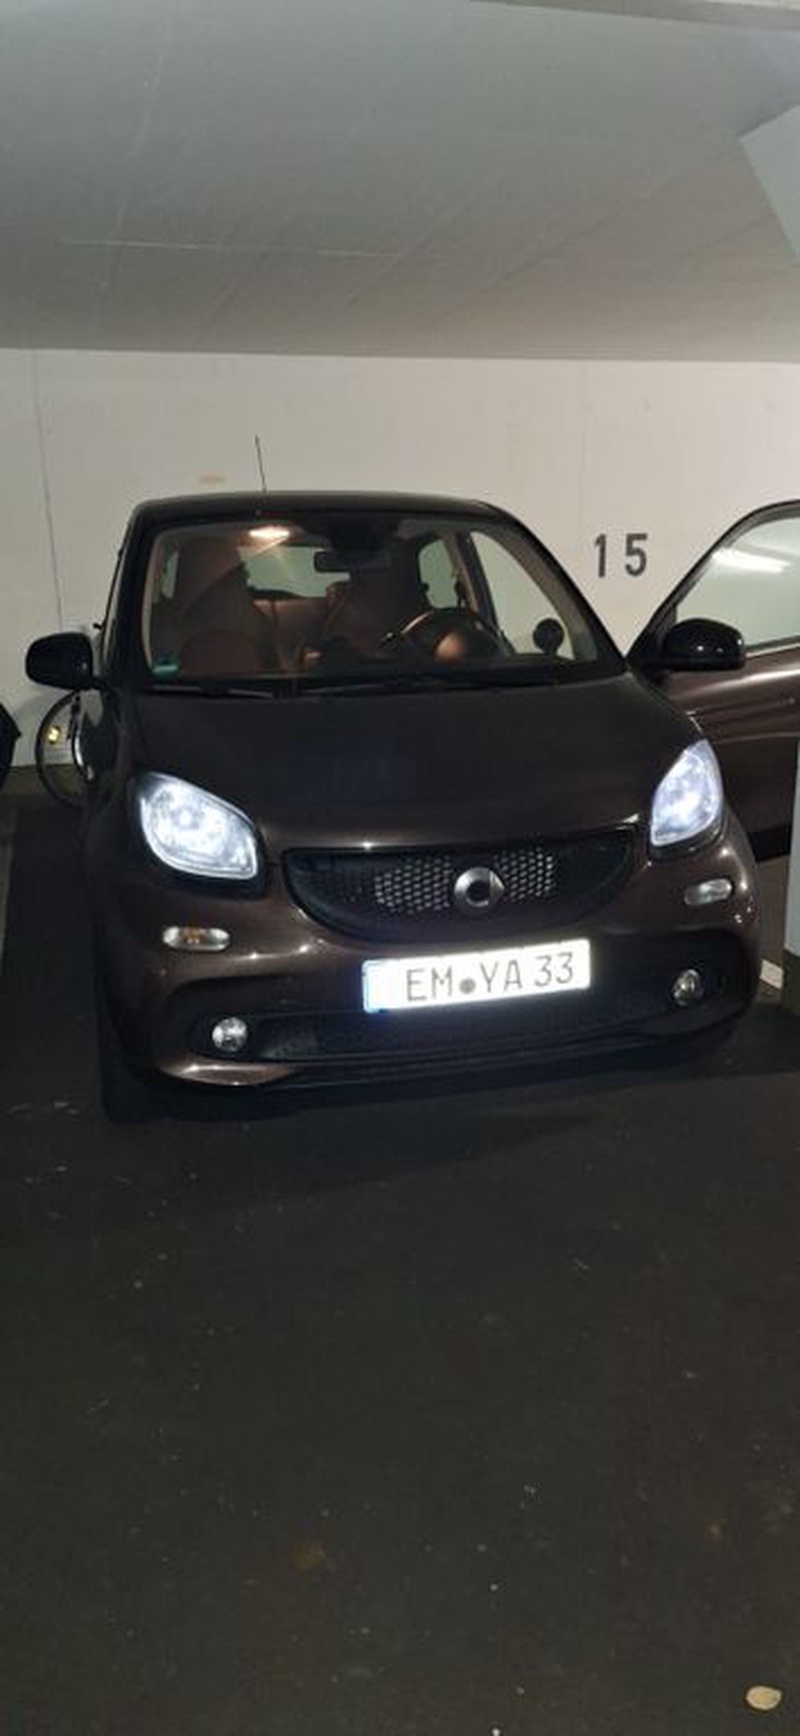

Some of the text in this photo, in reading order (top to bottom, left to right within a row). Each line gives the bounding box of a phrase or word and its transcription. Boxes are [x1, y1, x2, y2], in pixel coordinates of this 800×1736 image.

[594, 533, 648, 578] 15
[405, 951, 574, 1002] EM YA 33
